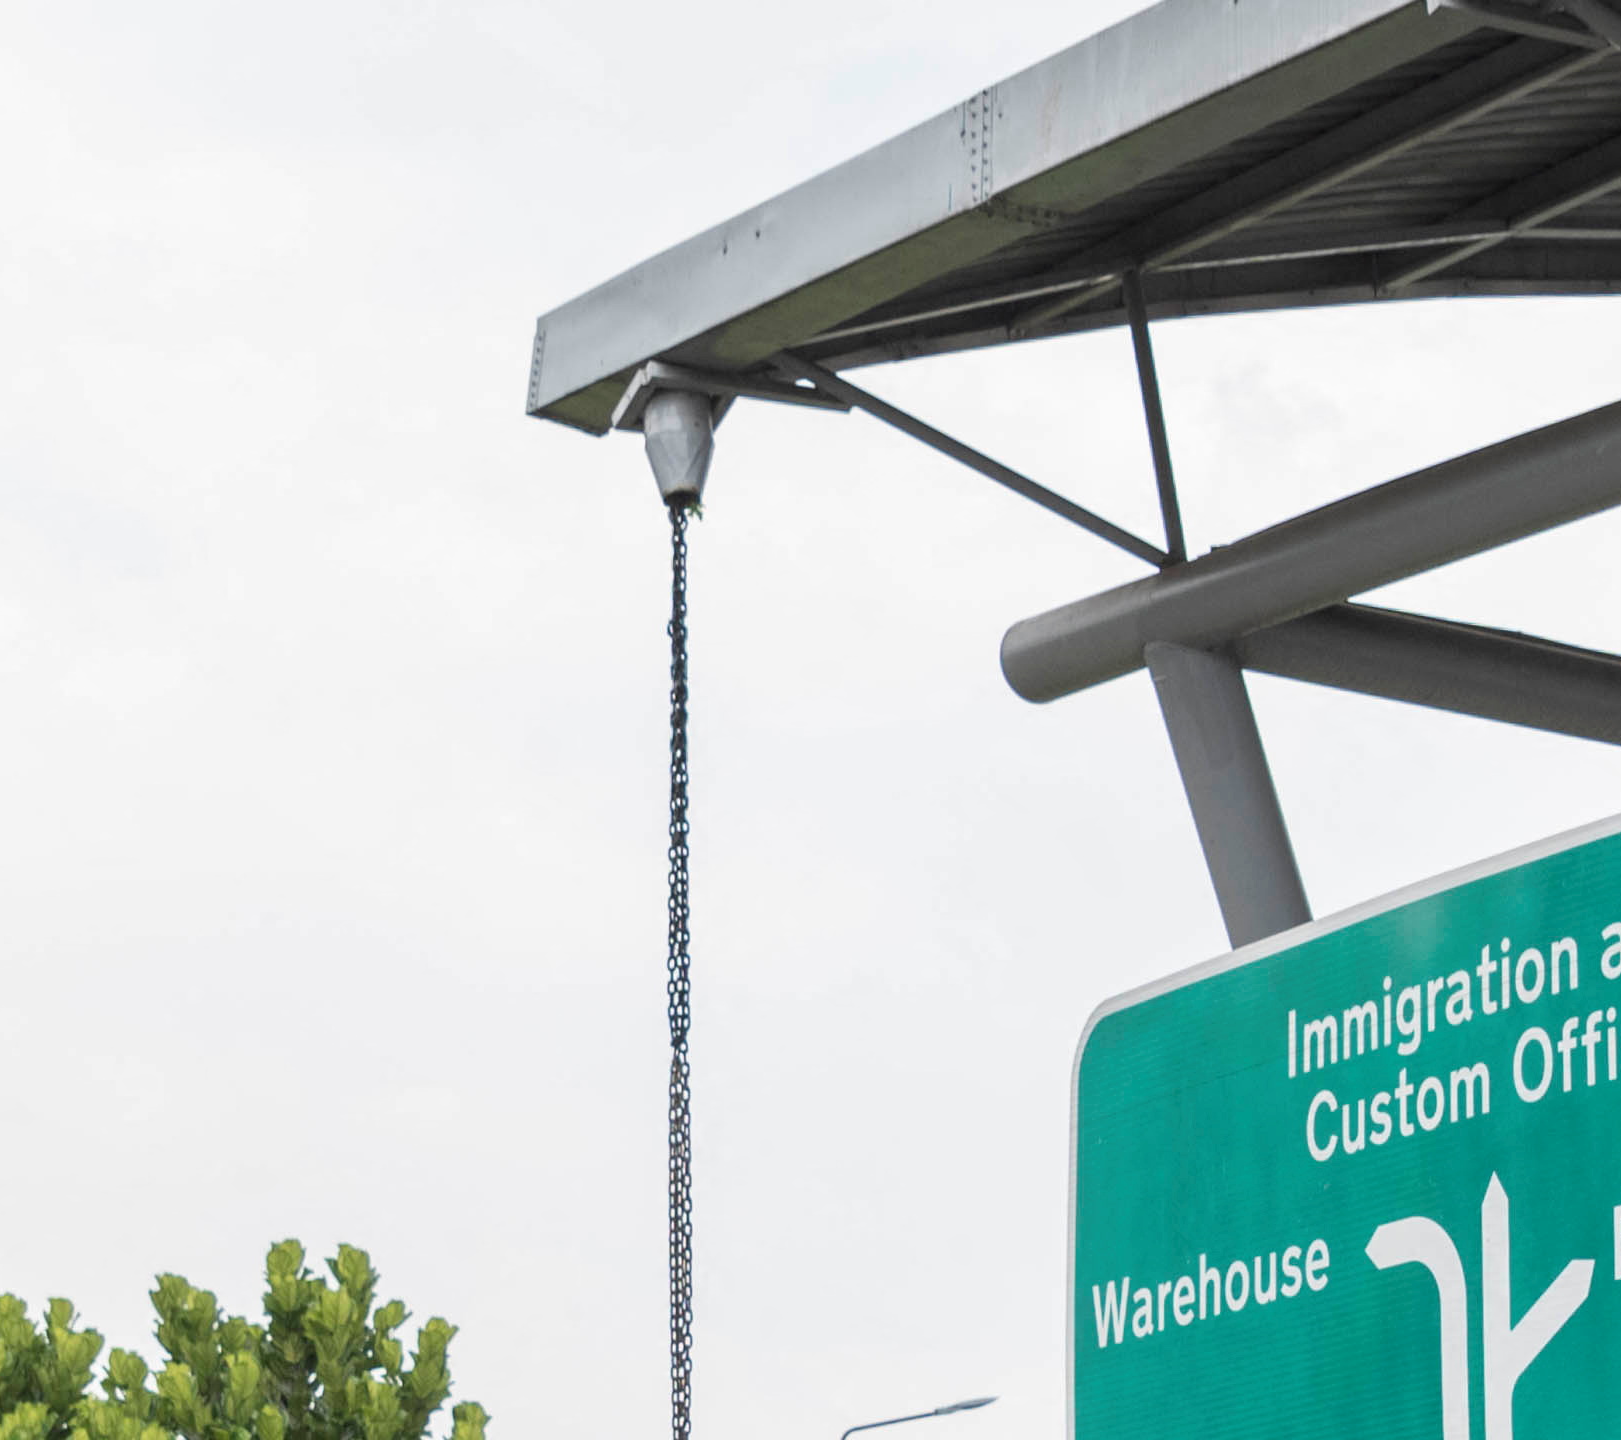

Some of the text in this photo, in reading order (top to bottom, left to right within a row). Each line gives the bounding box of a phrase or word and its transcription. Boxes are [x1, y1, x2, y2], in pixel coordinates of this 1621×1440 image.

[1288, 933, 1579, 1078] Immigration
[1306, 1058, 1491, 1162] Custom
[1092, 1239, 1330, 1348] Warehouse
